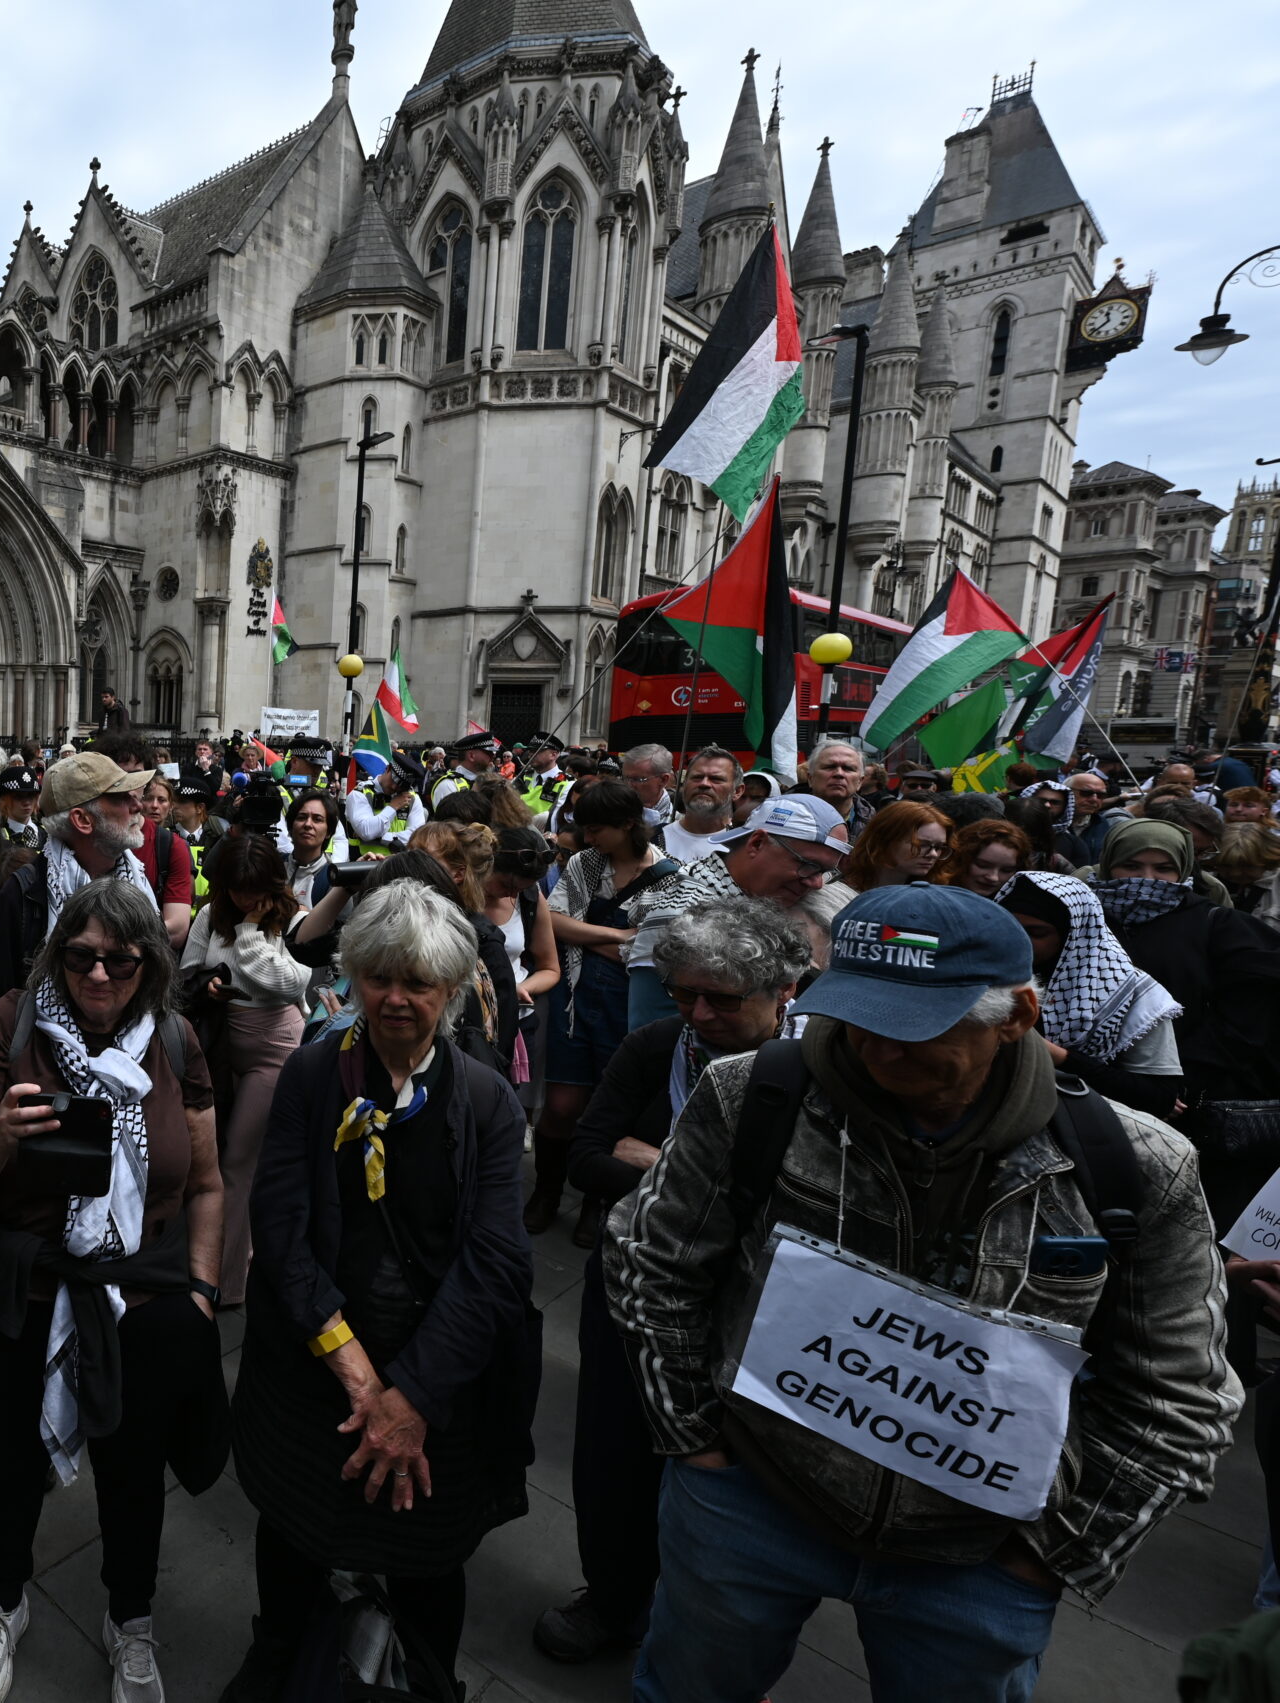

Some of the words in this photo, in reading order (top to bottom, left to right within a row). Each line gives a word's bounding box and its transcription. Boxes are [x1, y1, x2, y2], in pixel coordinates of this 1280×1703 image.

[249, 597, 267, 609] Royal
[251, 588, 265, 599] The
[246, 625, 267, 638] Justice
[837, 919, 881, 942] FREE
[833, 939, 937, 969] PALESTINE
[852, 1307, 990, 1376] JEWS
[800, 1334, 1016, 1434] AGAINST
[775, 1370, 1020, 1492] GENOCIDE
